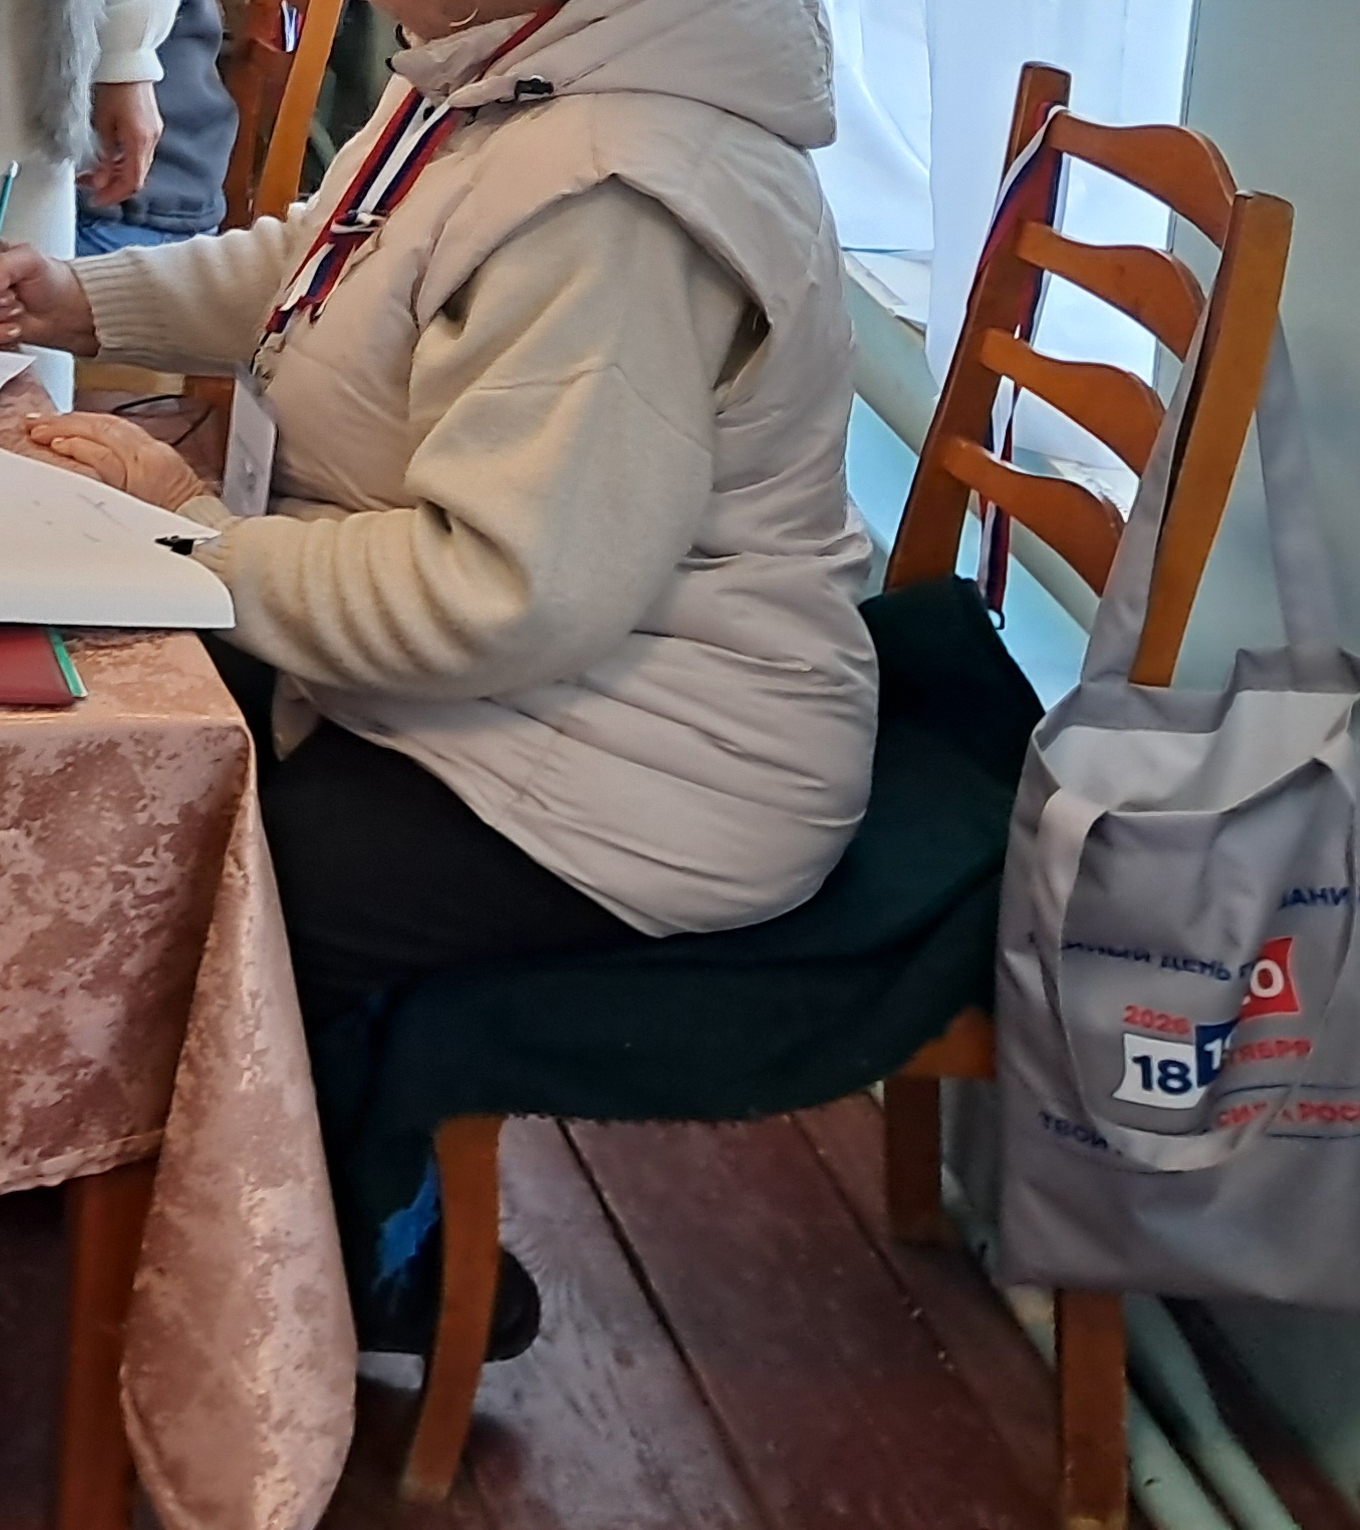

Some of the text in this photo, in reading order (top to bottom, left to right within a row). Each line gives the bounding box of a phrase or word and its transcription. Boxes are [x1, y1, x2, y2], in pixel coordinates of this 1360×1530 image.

[1132, 1054, 1193, 1096] 18
[1202, 1027, 1234, 1070] 1
[1241, 958, 1285, 1006] 0
